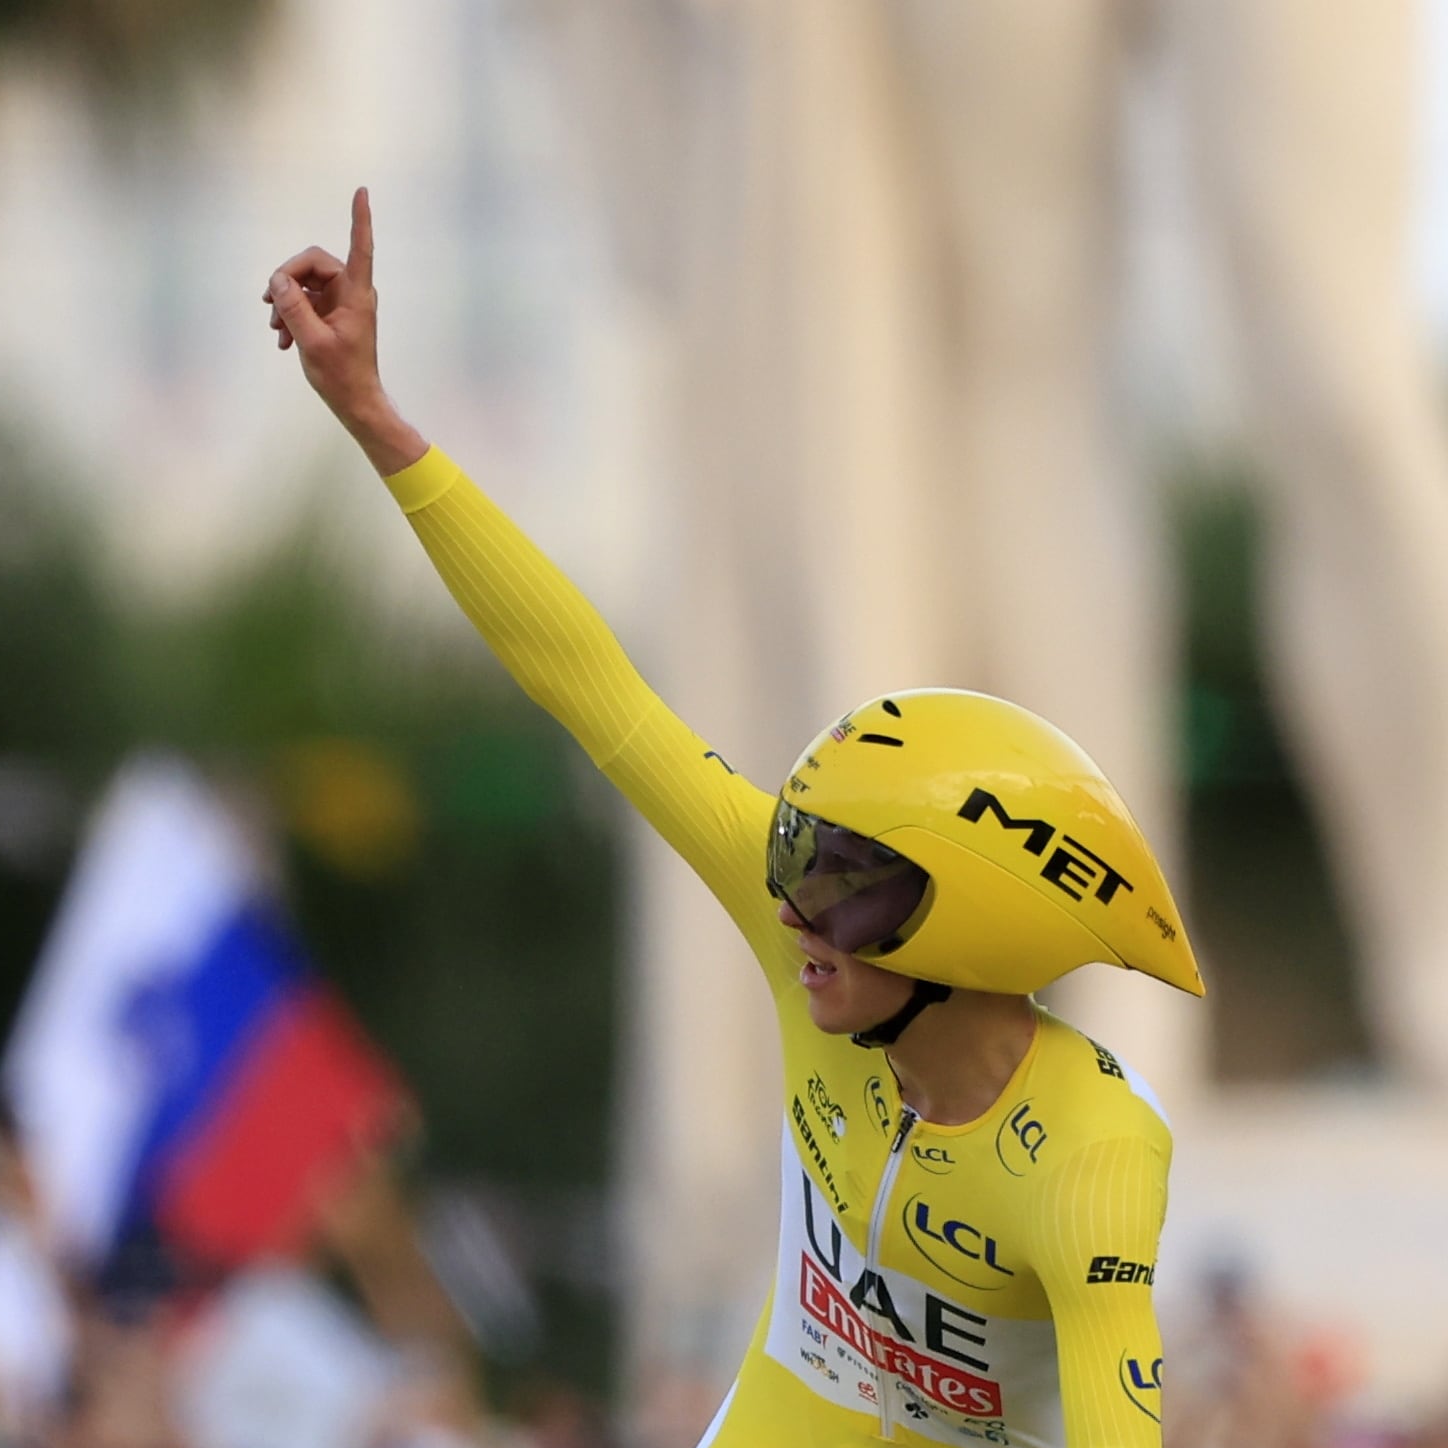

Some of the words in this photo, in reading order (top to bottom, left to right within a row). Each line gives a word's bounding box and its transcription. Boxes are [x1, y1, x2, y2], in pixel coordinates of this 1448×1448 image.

[957, 787, 1134, 906] MET
[792, 1094, 849, 1214] Santini
[870, 1080, 890, 1139] LCL
[912, 1144, 956, 1165] LCL
[1009, 1102, 1049, 1165] LCL
[802, 1166, 991, 1374] UAE
[916, 1201, 1015, 1278] LCL
[804, 1258, 994, 1413] Emirates
